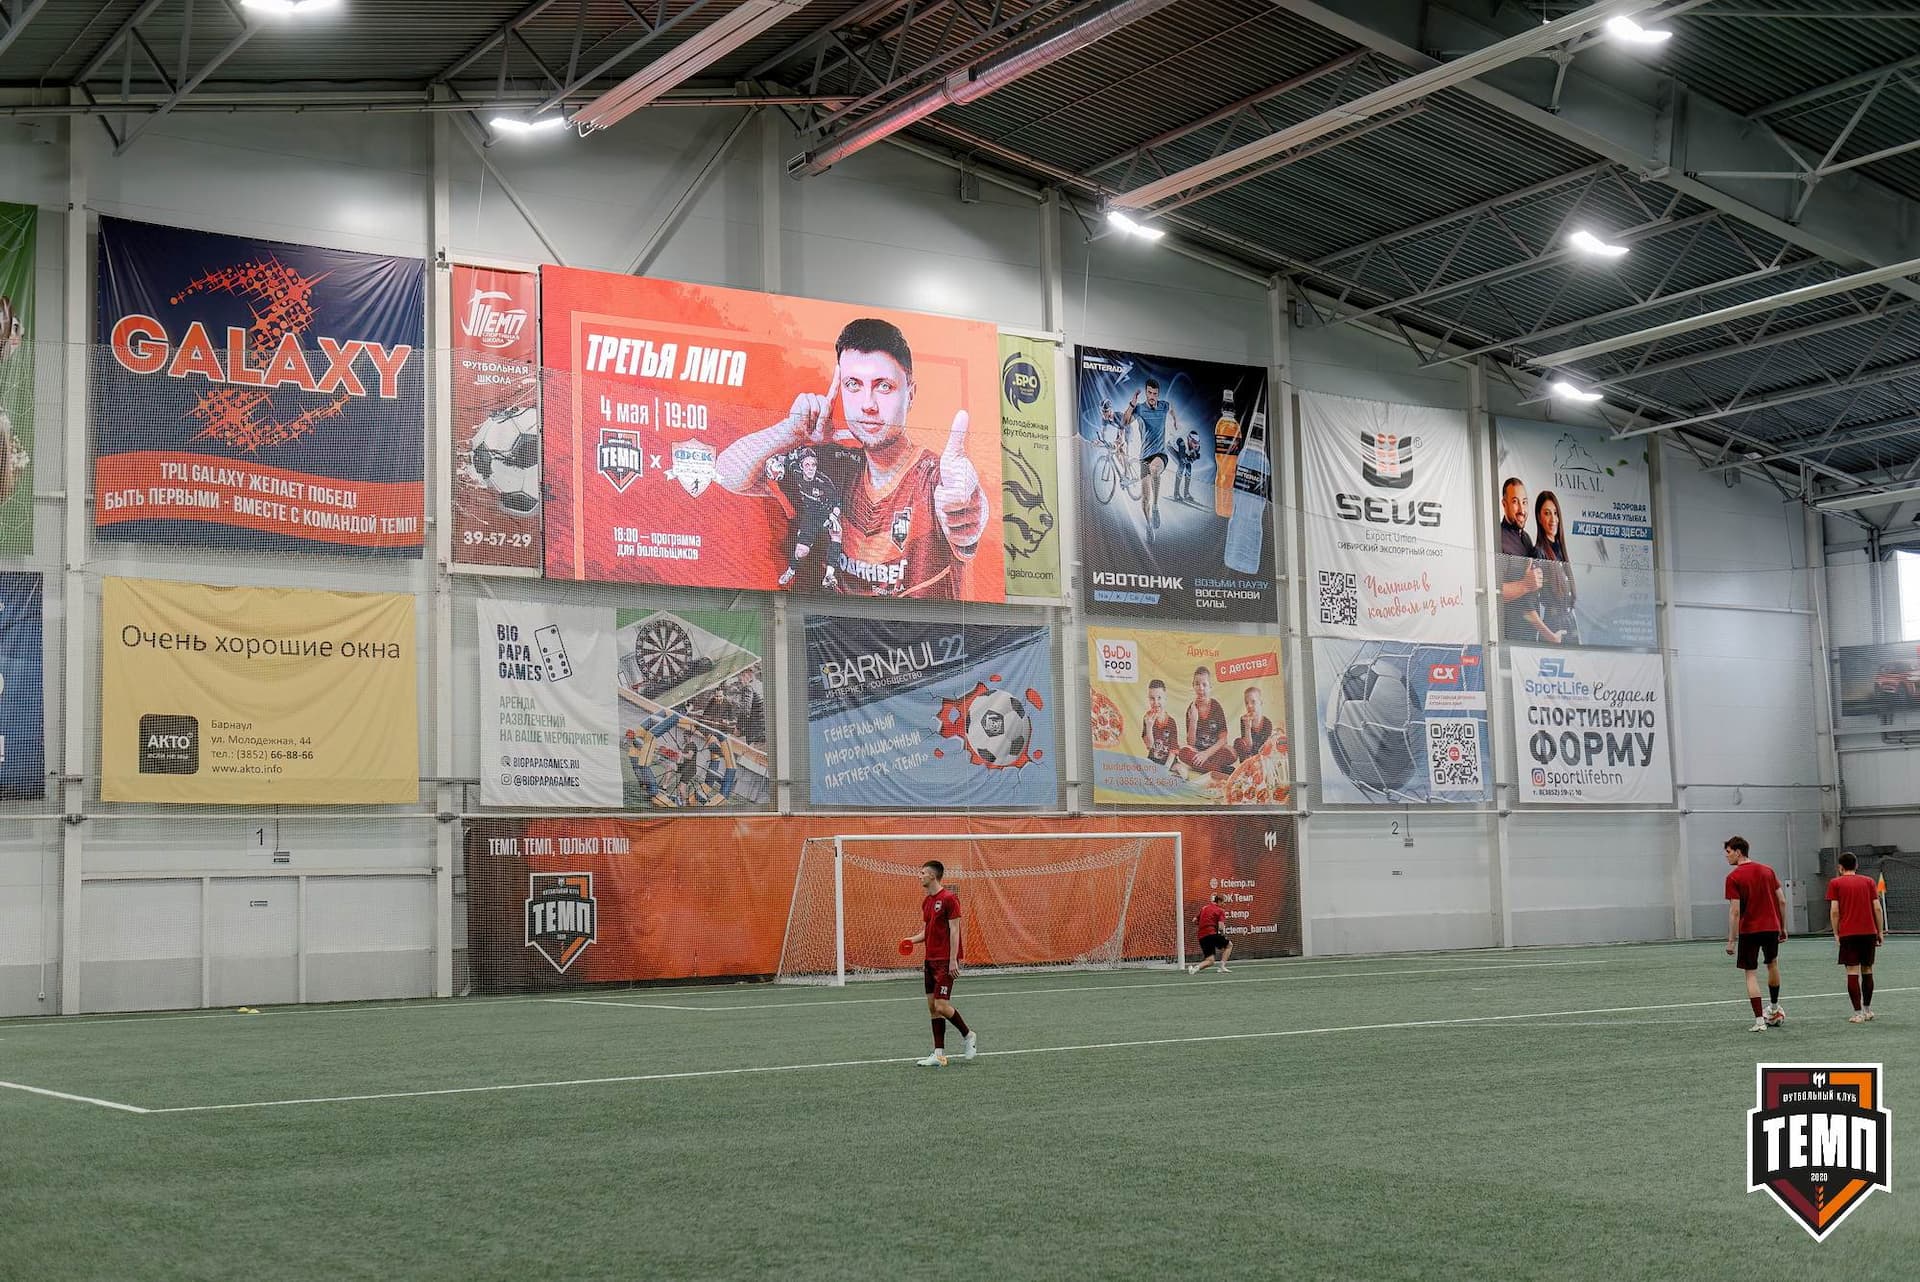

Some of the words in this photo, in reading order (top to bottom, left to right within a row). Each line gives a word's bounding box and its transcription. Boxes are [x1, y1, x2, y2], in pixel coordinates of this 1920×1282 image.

[111, 314, 411, 399] GALAXY
[586, 333, 678, 380] ТРЕТЬЯ
[679, 345, 747, 387] ЛИГА
[462, 360, 529, 375] ФУТБОЛЬНАЯ
[477, 374, 511, 385] ШКОЛА
[600, 394, 612, 421] 4
[616, 402, 649, 425] мая
[664, 401, 708, 431] 19:00
[601, 447, 640, 470] ТЕМП
[160, 462, 189, 482] ТРЦ
[191, 464, 244, 489] GALAXY
[249, 473, 304, 500] ЖЕЛАЕТ
[307, 484, 358, 508] ПОБЕД!
[104, 487, 144, 510] БЫТЬ
[148, 488, 220, 509] ПЕРВЫМИ
[234, 495, 287, 522] ВМЕСТЕ
[290, 511, 300, 523] С
[303, 507, 378, 535] КОМАНДОЙ
[380, 517, 418, 534] ТЕМП!
[1335, 492, 1443, 528] SEUS
[1588, 511, 1621, 520] КРАСИВАЯ
[1612, 502, 1647, 512] ЗДОРОВАЯ
[462, 530, 532, 548] 39-57-29
[614, 527, 638, 542] 18:00
[651, 532, 702, 547] программа
[1578, 523, 1601, 535] ЖДЕТ
[1601, 525, 1620, 536] ТЕБЯ
[1621, 527, 1648, 538] ЗДЕСЬ!
[617, 544, 635, 557] для
[637, 543, 699, 560] болельщиков
[1337, 541, 1379, 553] СИБИРСКИЙ
[1380, 545, 1425, 556] ЭКСПОРТНЫЙ
[1426, 549, 1443, 557] СОЮЗ
[1092, 571, 1184, 590] ИЗОТОНИК
[1194, 578, 1236, 589] ВОЗЬМИ
[1238, 580, 1269, 589] ПАУЗУ
[1363, 575, 1420, 598] Чемпион
[1421, 572, 1431, 592] в
[1195, 589, 1261, 600] ВОССТАНОВИ
[1368, 596, 1421, 619] каждом
[1423, 598, 1437, 616] из
[1439, 584, 1464, 608] нас!
[1196, 599, 1227, 609] СИЛЫ.
[496, 623, 519, 642] BIG
[121, 624, 207, 653] Очень
[214, 633, 334, 660] хорошие
[340, 637, 401, 659] окна
[498, 643, 531, 662] PAPA
[1103, 644, 1132, 660] BuDu
[498, 662, 543, 682] GAMES
[1105, 660, 1132, 670] FOOD
[1229, 658, 1269, 675] детства
[1537, 657, 1575, 678] SL
[825, 683, 865, 698] ИНТЕРНЕТ
[870, 670, 923, 689] СООБЩЕСТВО
[1525, 680, 1590, 697] SportLife
[499, 695, 536, 711] АРЕНДА
[210, 719, 252, 731] Барнаул
[499, 712, 566, 728] РАЗВЛЕЧЕНИЙ
[1527, 706, 1655, 729] СПОРТИВНУЮ
[823, 711, 896, 744] ГЕНЕРАЛЬНЫЙ
[147, 734, 190, 750] АКТО
[210, 735, 225, 745] ул.
[299, 737, 312, 746] 44
[500, 729, 513, 742] НА
[515, 729, 543, 743] ВАШЕ
[544, 731, 609, 746] МЕРОПРИЯТИЕ
[211, 749, 235, 760] тел.:
[236, 749, 268, 761] (3852)
[270, 750, 314, 761] 66-88-66
[824, 730, 921, 767] ИНФОРМАЦИОННЫЙ
[1529, 729, 1655, 767] ФОРМУ
[211, 764, 283, 775] www.akto.info
[513, 757, 580, 770] BIGPAPAGAMES.RU
[513, 774, 581, 788] @BIGPAPAGAMES
[824, 765, 871, 790] ПАРТНЕР
[871, 761, 890, 776] ФК
[1547, 769, 1624, 788] sportlifebrn
[256, 827, 264, 846] 1
[1391, 821, 1399, 835] 2
[488, 837, 521, 857] ТЕМП,
[523, 837, 556, 857] ТЕМП,
[558, 837, 599, 855] ТОЛЬКО
[601, 837, 631, 855] ТЕМП!
[1220, 879, 1256, 889] fctemp.ru
[1234, 893, 1254, 902] Темп
[532, 900, 591, 936] ТЕМП
